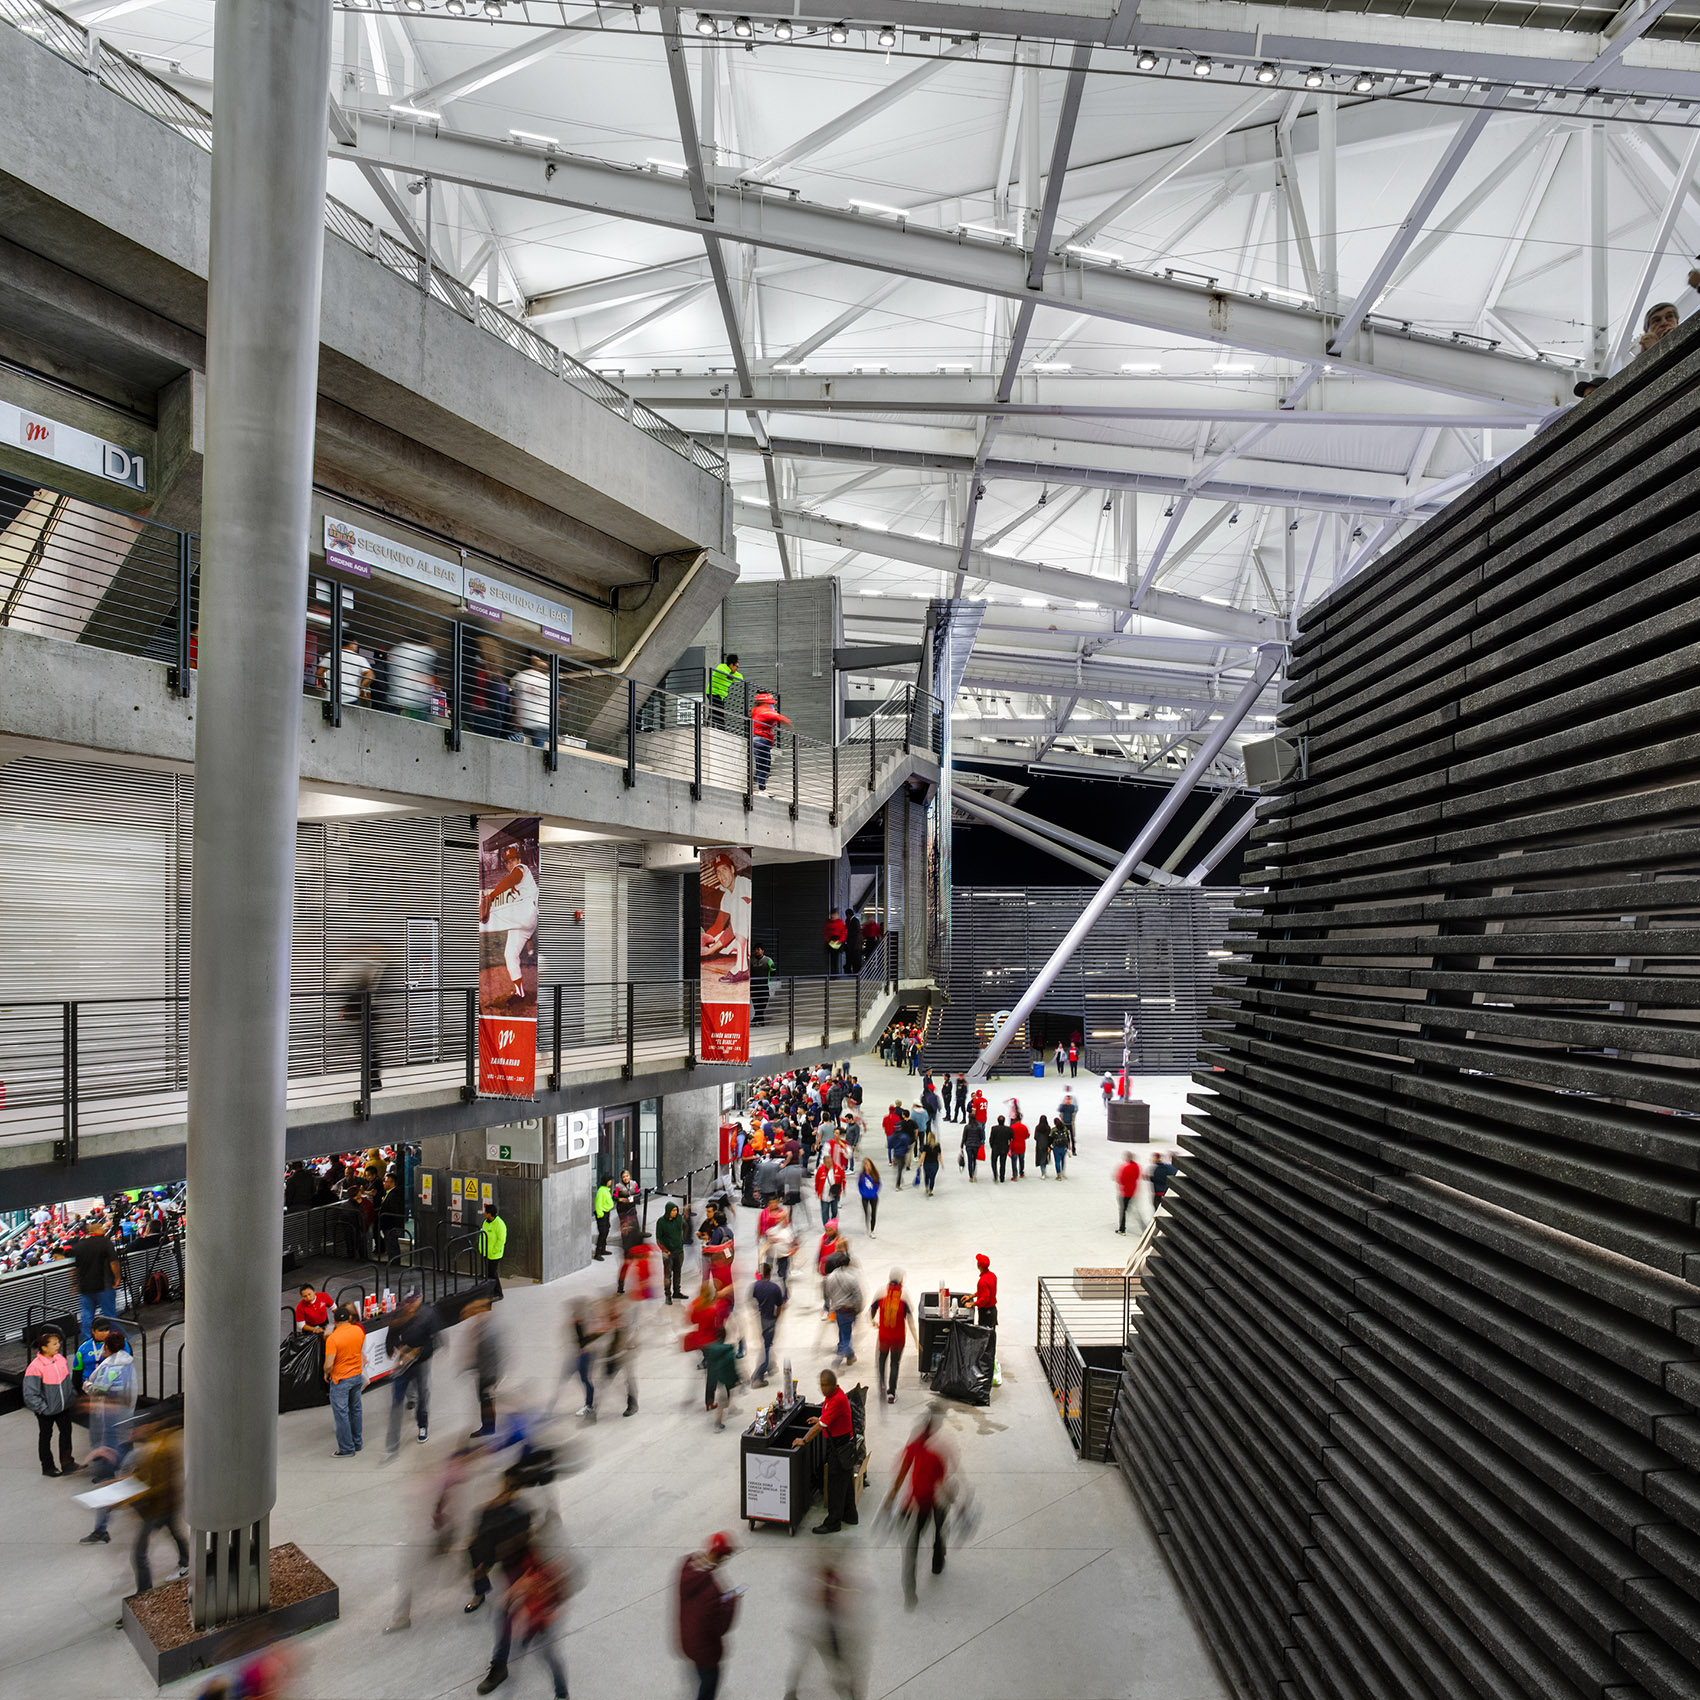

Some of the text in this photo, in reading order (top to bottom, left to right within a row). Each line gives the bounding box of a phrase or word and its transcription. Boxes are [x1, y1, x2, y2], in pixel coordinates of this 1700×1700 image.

[104, 445, 144, 488] D1
[330, 555, 353, 569] ORDENE
[357, 537, 456, 583] SEGUNDO AL BAR
[489, 585, 535, 610] SEGUNDO
[535, 604, 548, 617] AL
[549, 607, 568, 624] BAR
[567, 1112, 590, 1161] B
